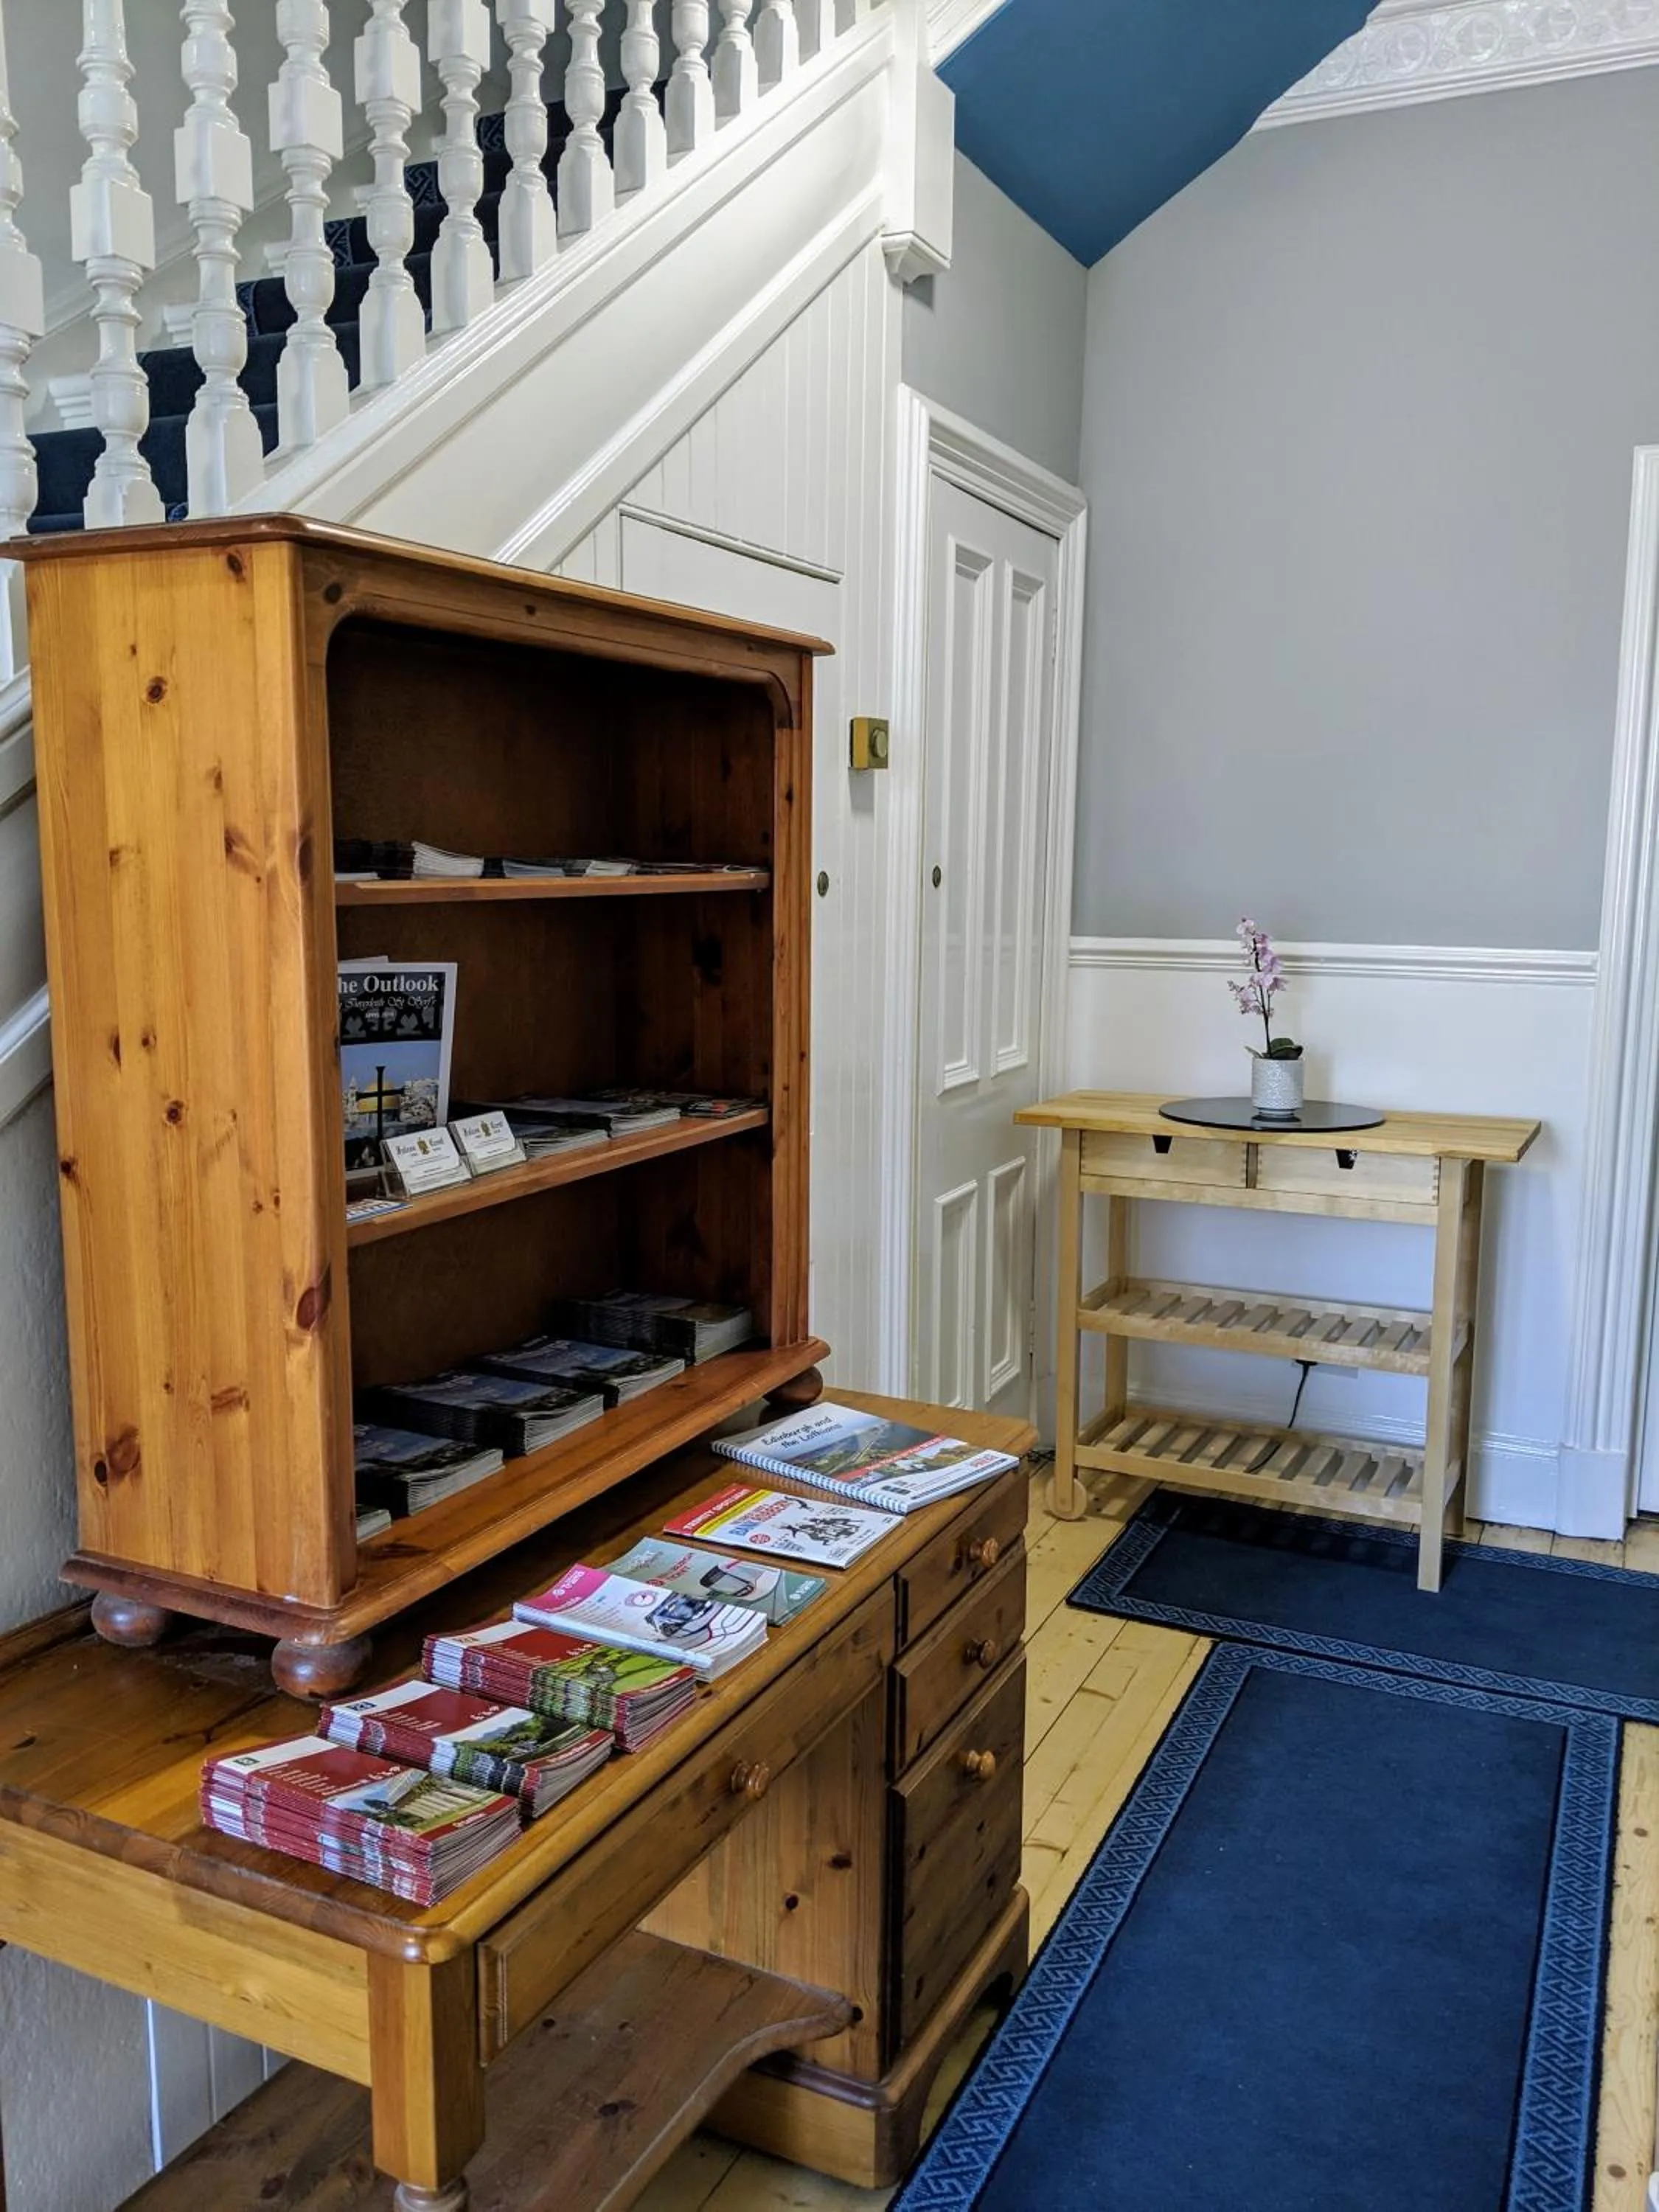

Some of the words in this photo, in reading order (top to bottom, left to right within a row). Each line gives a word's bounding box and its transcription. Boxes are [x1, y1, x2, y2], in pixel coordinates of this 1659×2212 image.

[337, 975, 358, 994] he
[363, 974, 439, 993] Outlook
[761, 1424, 813, 1445] Edinburgh
[814, 1416, 832, 1427] and
[781, 1440, 800, 1449] the
[799, 1423, 844, 1441] Lothians
